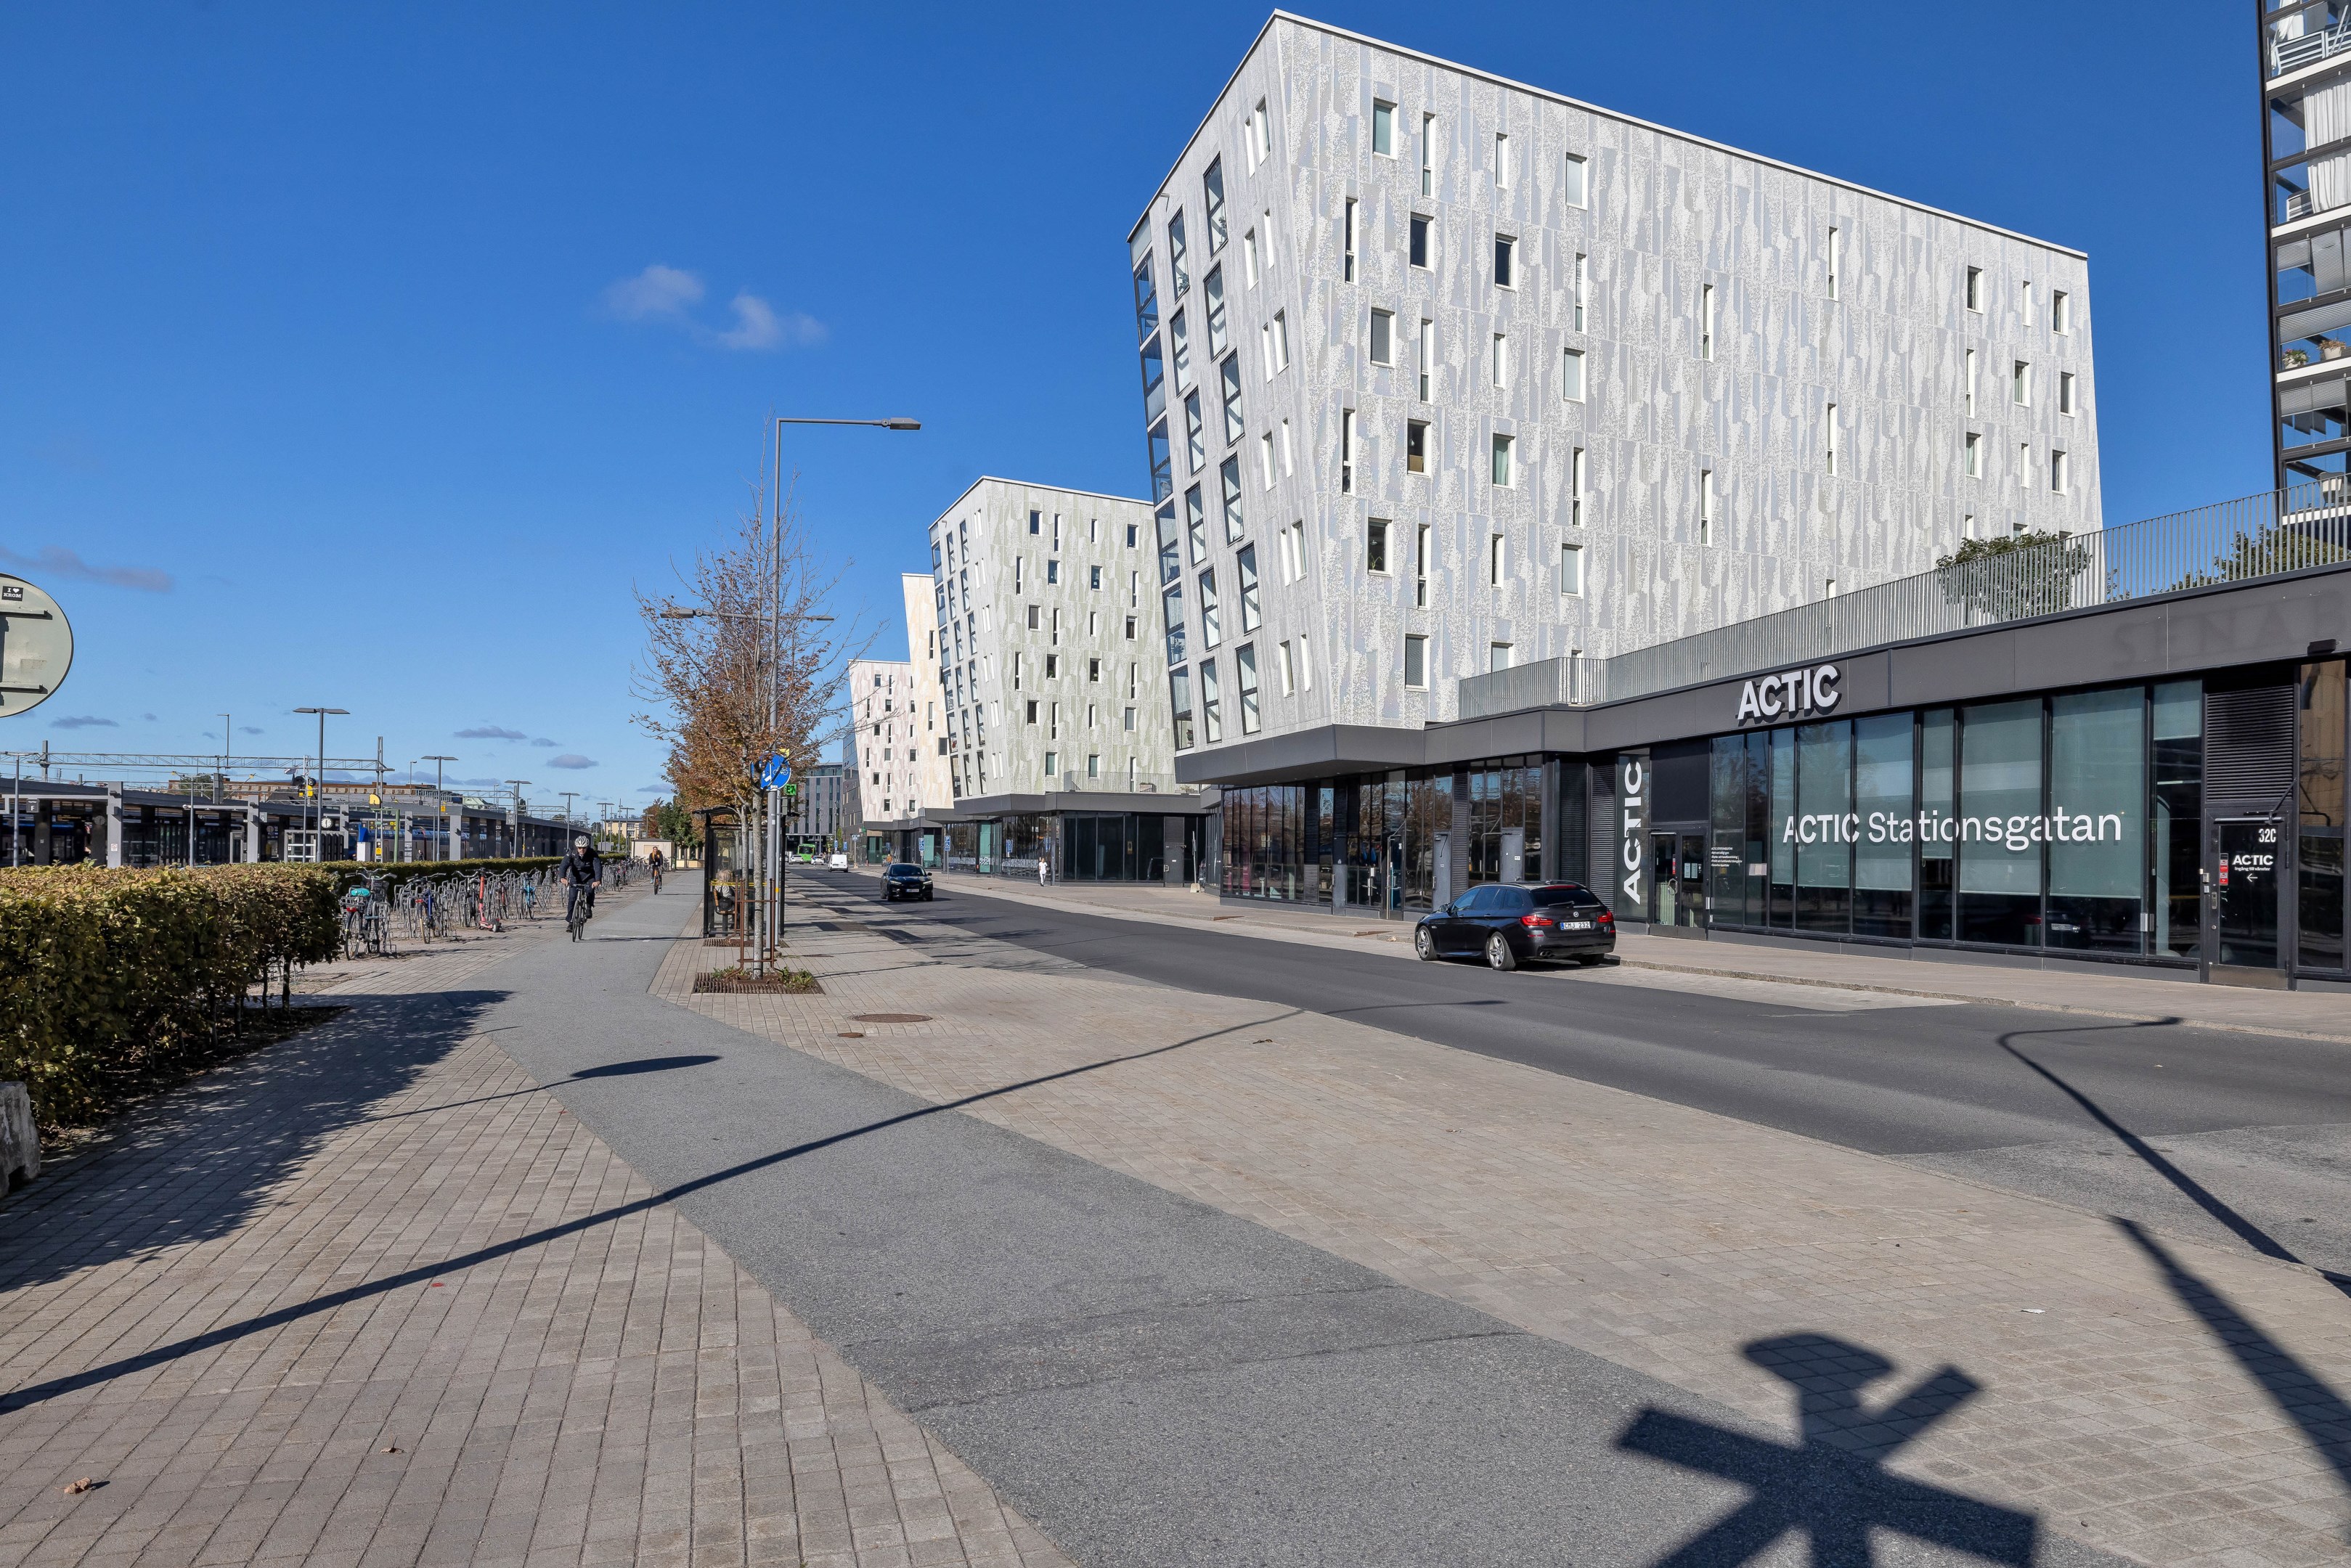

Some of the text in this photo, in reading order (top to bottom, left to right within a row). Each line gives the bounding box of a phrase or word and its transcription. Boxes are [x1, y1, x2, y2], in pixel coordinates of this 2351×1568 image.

[1737, 664, 1840, 720] ACTIC
[1623, 761, 1642, 905] ACTIC
[1782, 806, 2121, 852] ACTIC Stationsgatan
[2258, 828, 2277, 843] 32C
[2232, 854, 2274, 865] ACTIC
